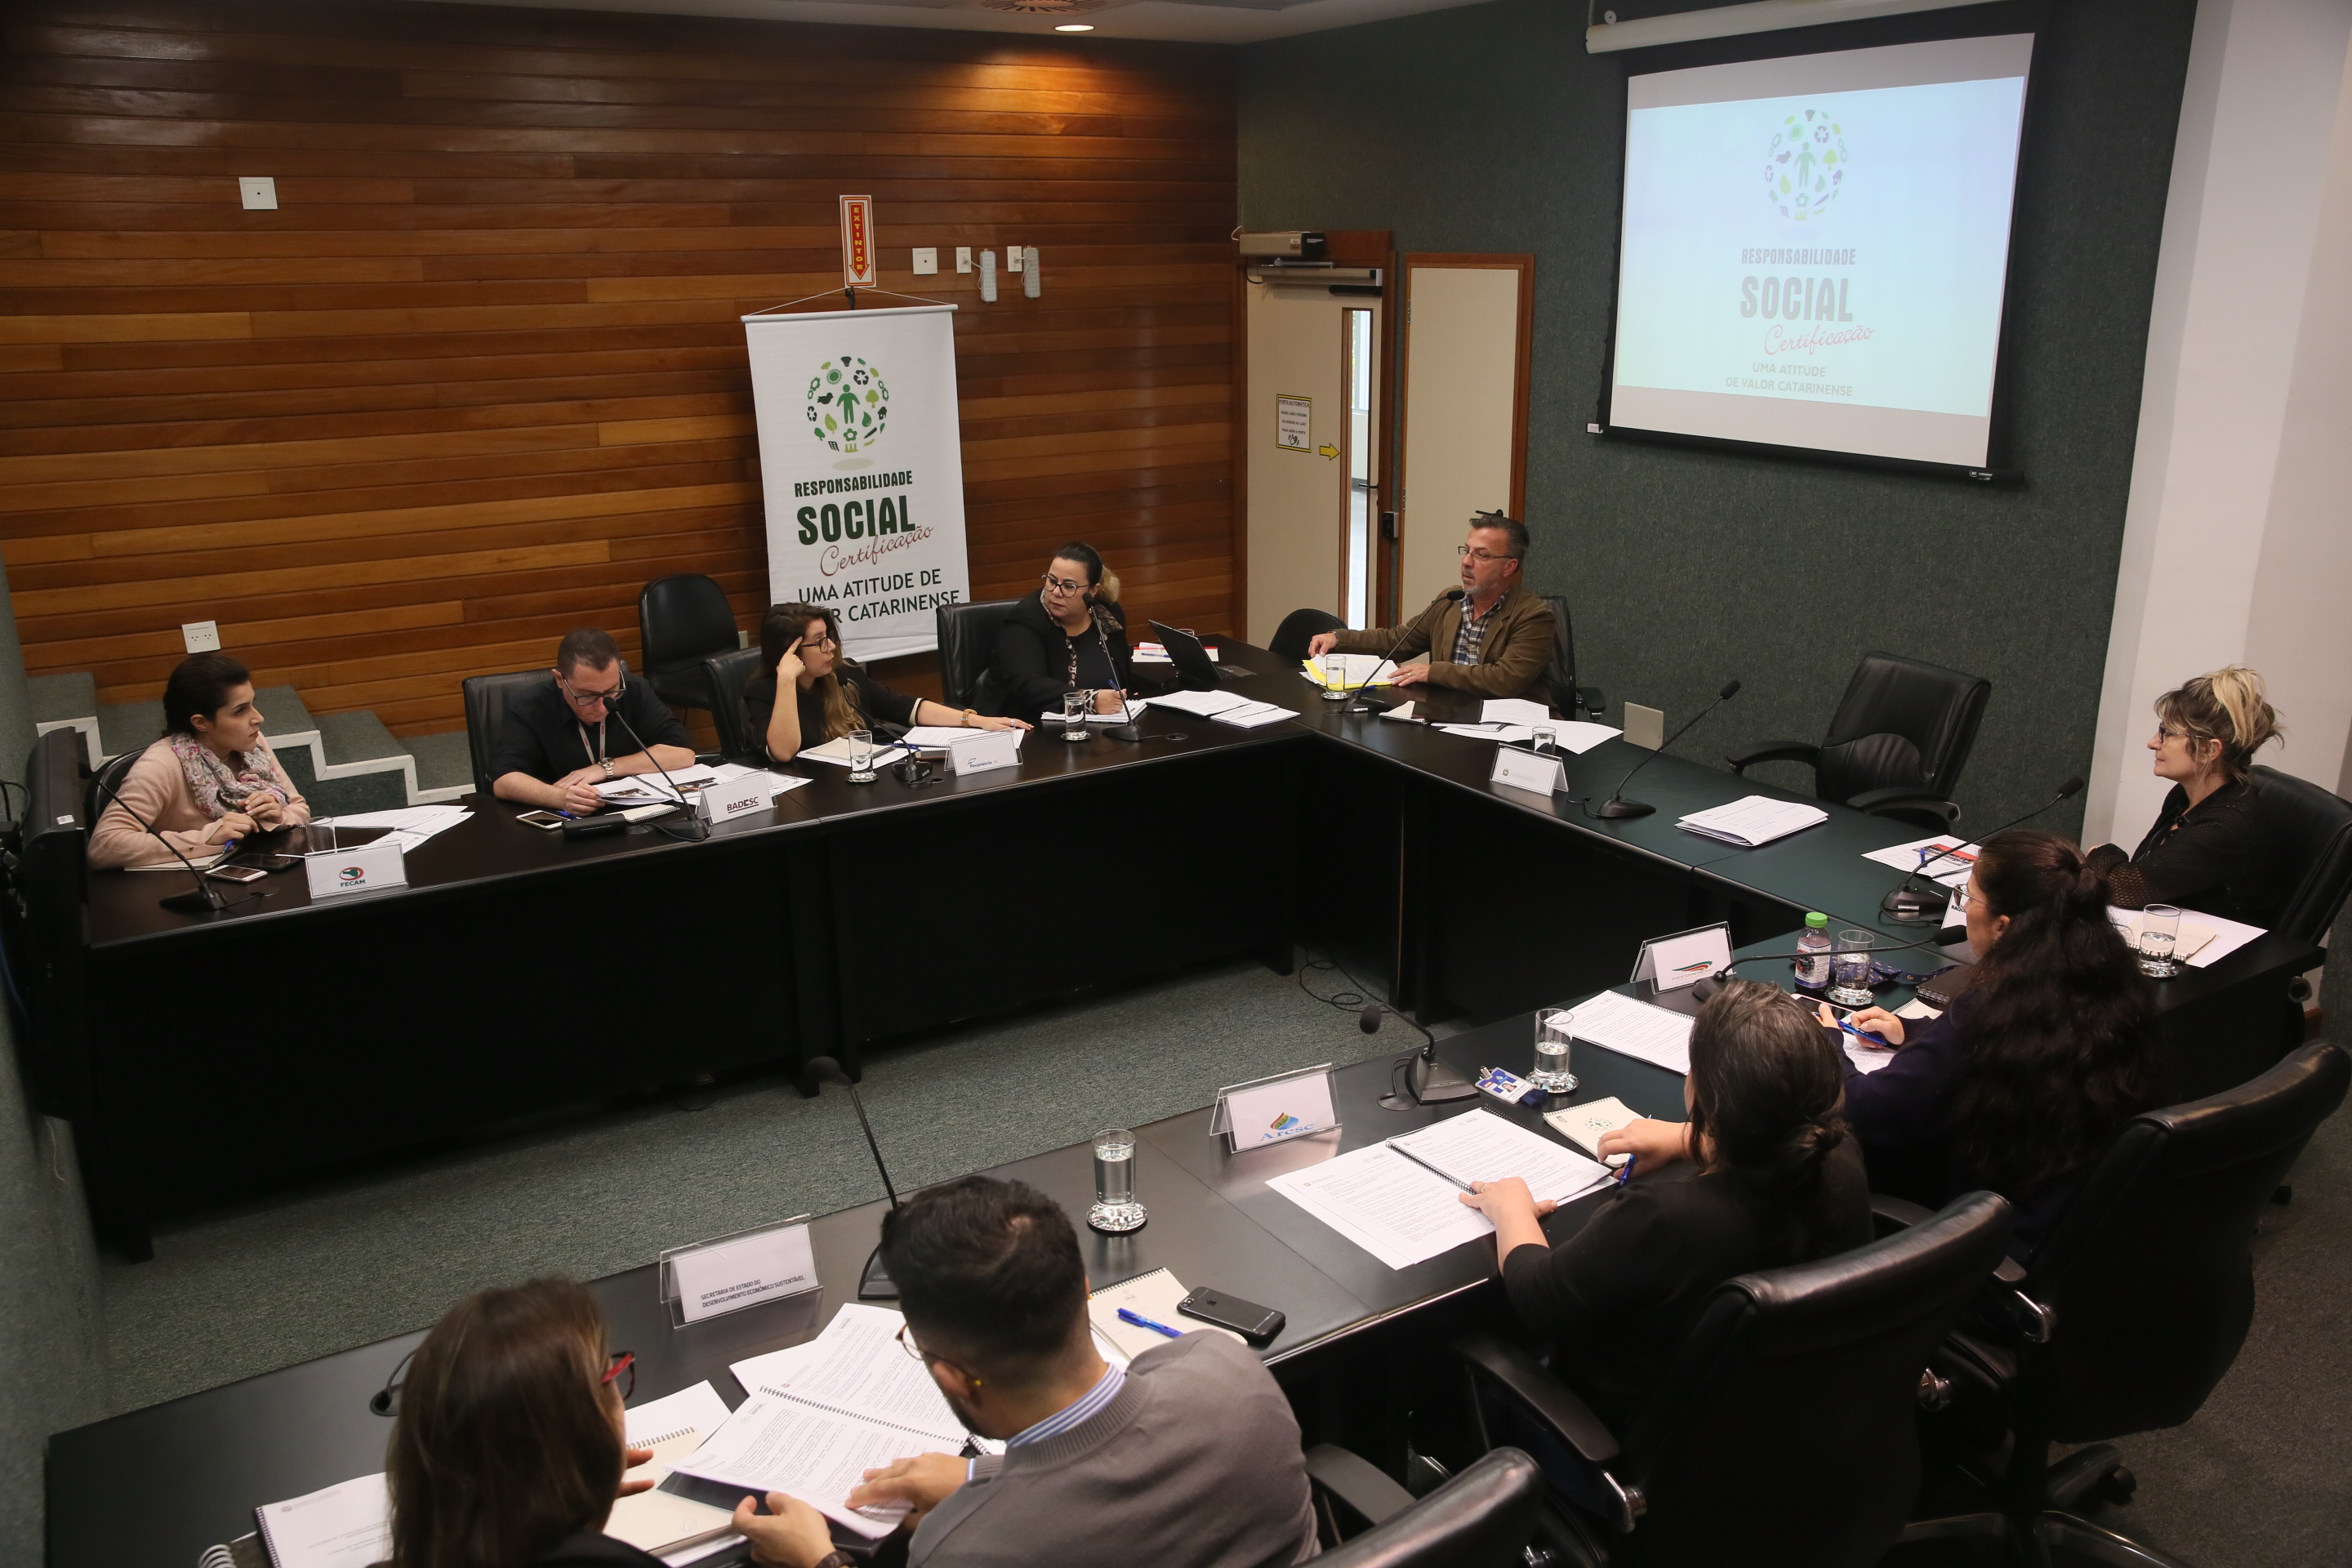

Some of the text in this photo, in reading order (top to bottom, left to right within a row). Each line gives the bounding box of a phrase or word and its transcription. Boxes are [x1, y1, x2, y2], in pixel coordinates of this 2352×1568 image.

[853, 207, 863, 270] EXTINTOR
[1741, 248, 1856, 265] RESPONSABILIDADE
[1740, 275, 1853, 322] SOCIAL
[1764, 323, 1874, 355] Certificação
[1752, 362, 1826, 377] UMA ATITUDE
[1726, 376, 1853, 396] DE VALOR CATARINENSE
[795, 470, 913, 497] RESPONSABILIDADE
[796, 495, 915, 546] SOCIAL
[819, 524, 934, 577] Certificação
[799, 568, 942, 604] UMA ATITUDE DE
[848, 590, 960, 622] CATARINENSE
[727, 796, 759, 811] BADESC
[341, 879, 366, 888] FECAM
[1260, 1124, 1315, 1142] Aresc
[701, 1288, 729, 1300] SECRETARIA
[736, 1281, 754, 1291] ESTADO
[702, 1275, 805, 1307] DESENVOLVIMENTO ECONÔMICO SUSTENTÁVEL
